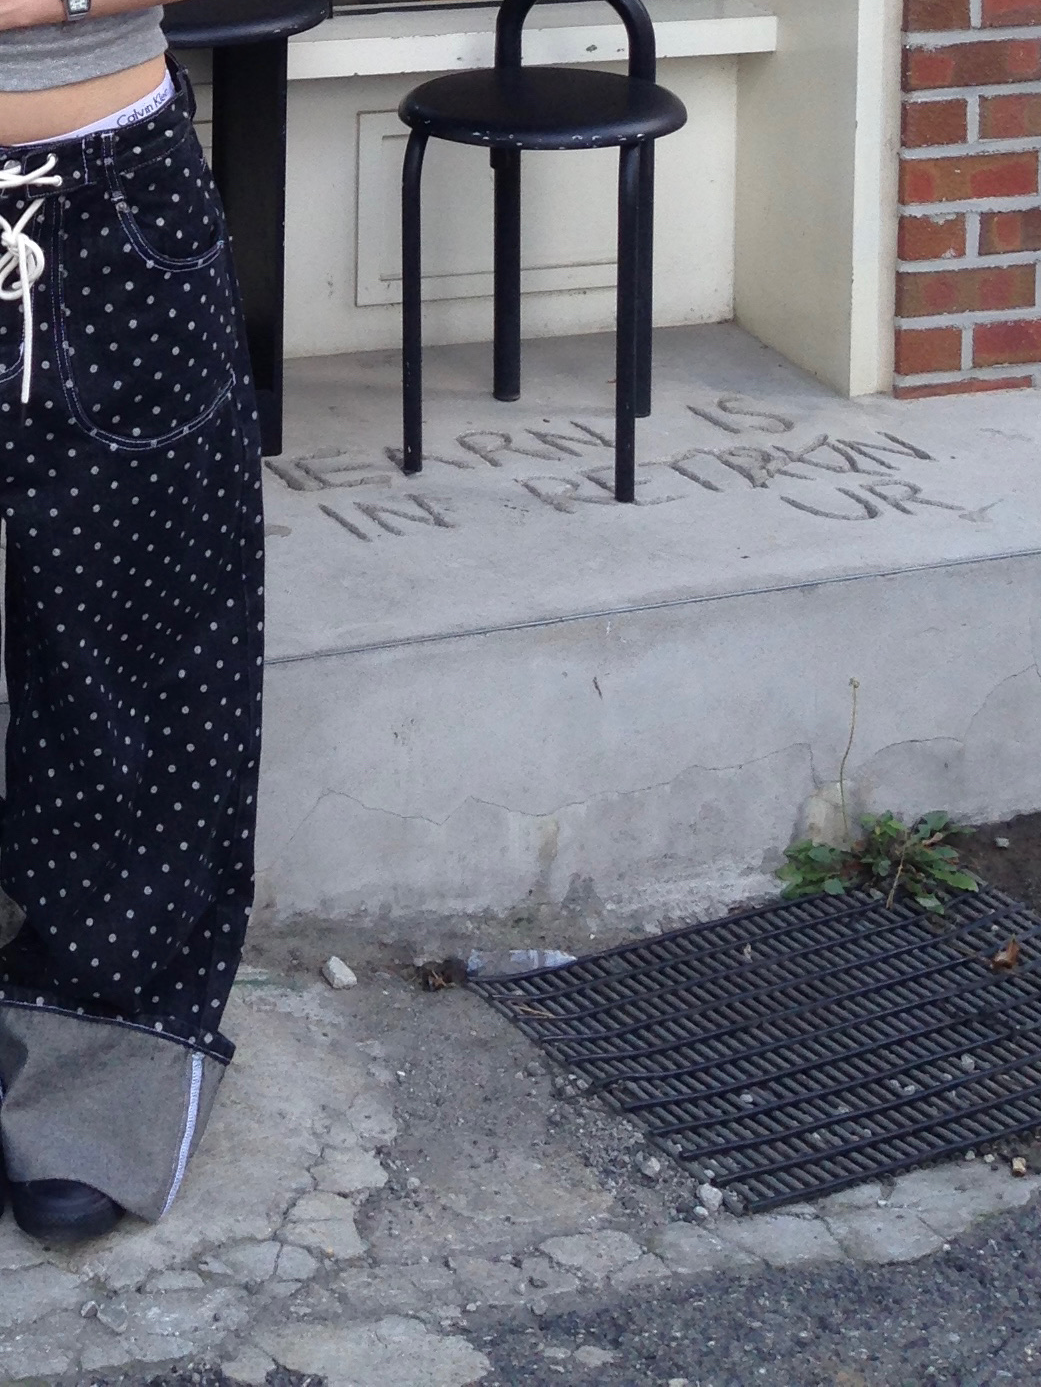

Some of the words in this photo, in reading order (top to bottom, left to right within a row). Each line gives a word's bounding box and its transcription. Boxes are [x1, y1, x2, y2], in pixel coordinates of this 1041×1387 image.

[116, 102, 154, 128] Calvin
[686, 394, 795, 434] IS
[318, 493, 456, 542] IN
